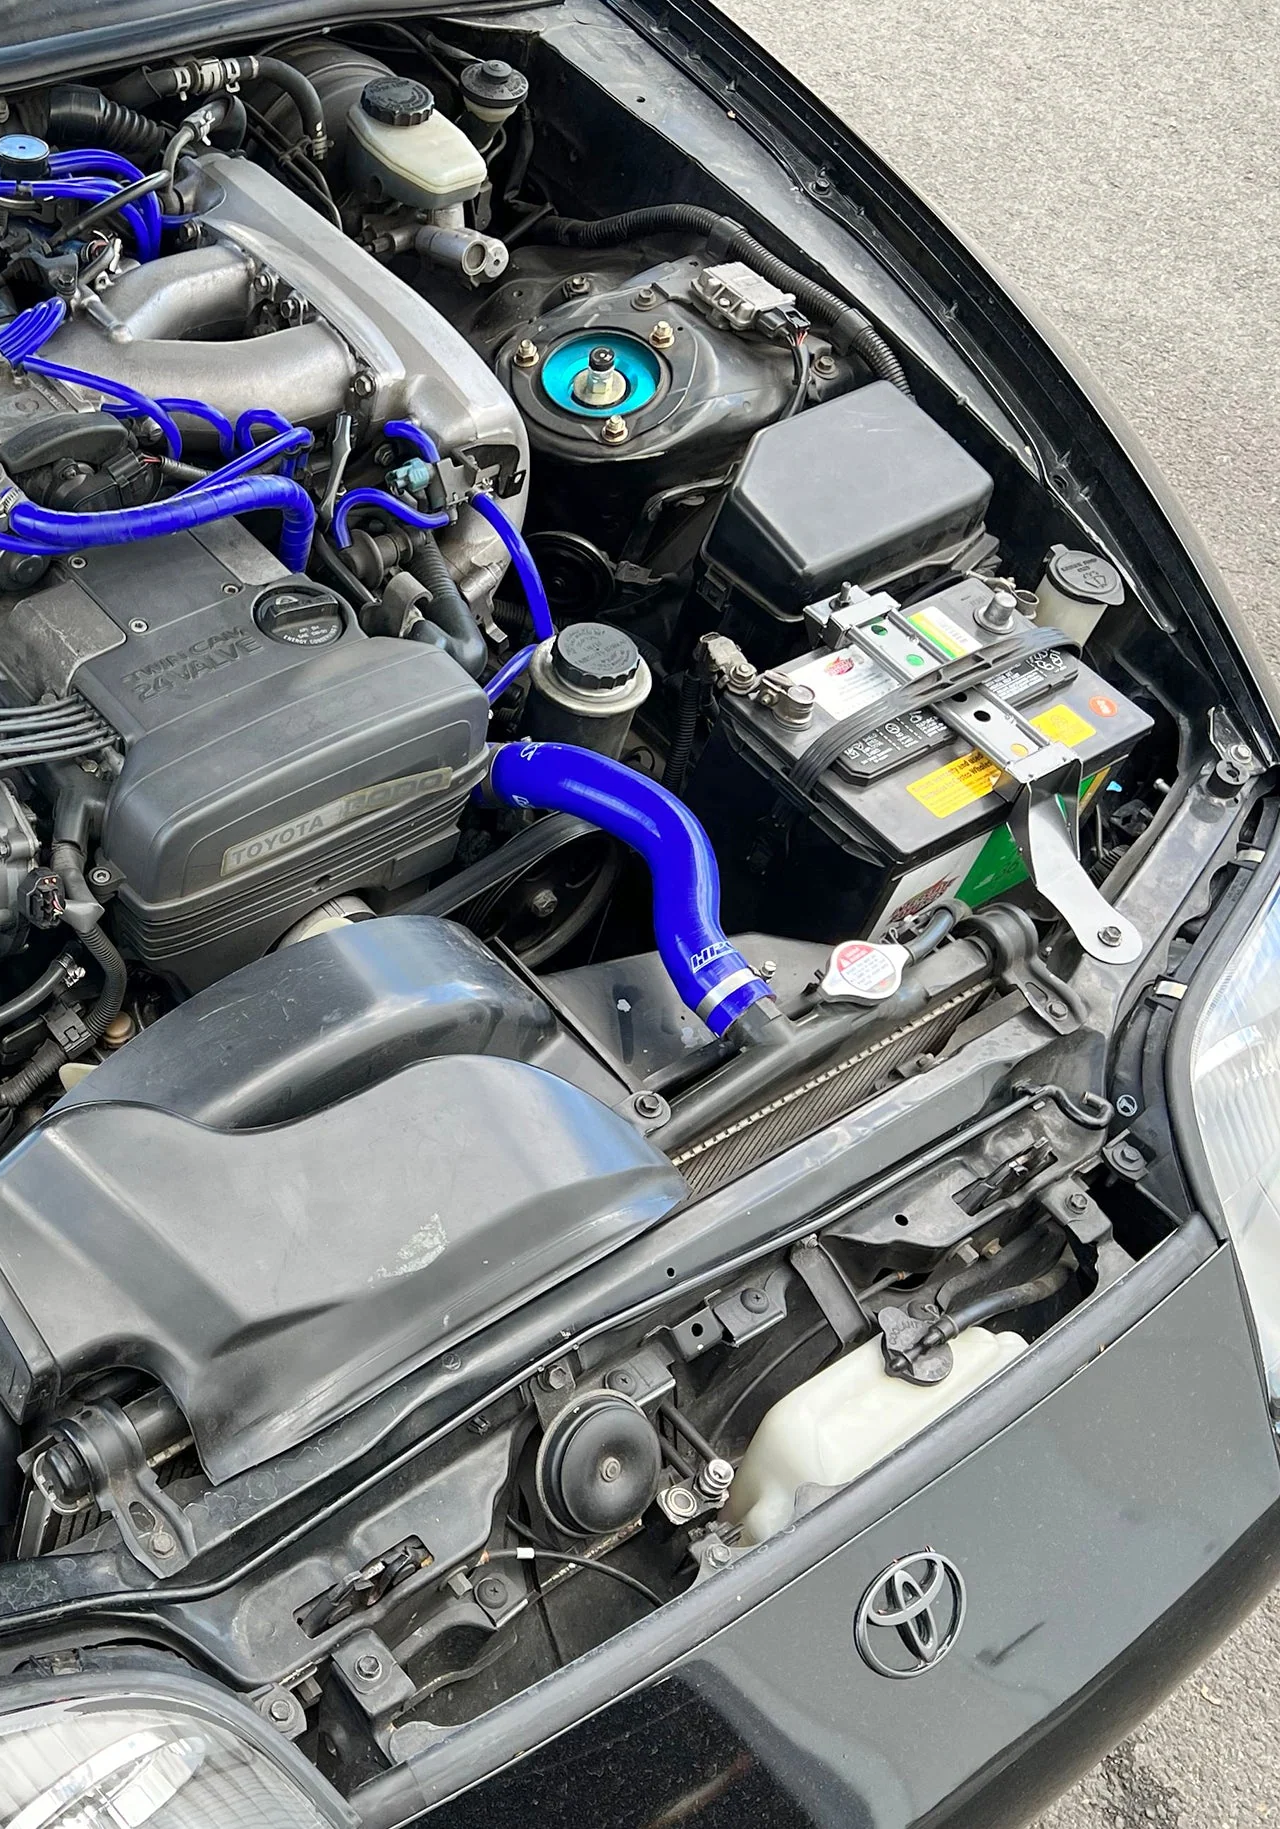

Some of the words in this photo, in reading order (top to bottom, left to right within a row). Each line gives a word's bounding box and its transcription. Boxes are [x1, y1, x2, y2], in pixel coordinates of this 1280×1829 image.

[121, 650, 189, 685] TWIN
[188, 626, 249, 657] CAM
[231, 814, 324, 866] TOYOTA
